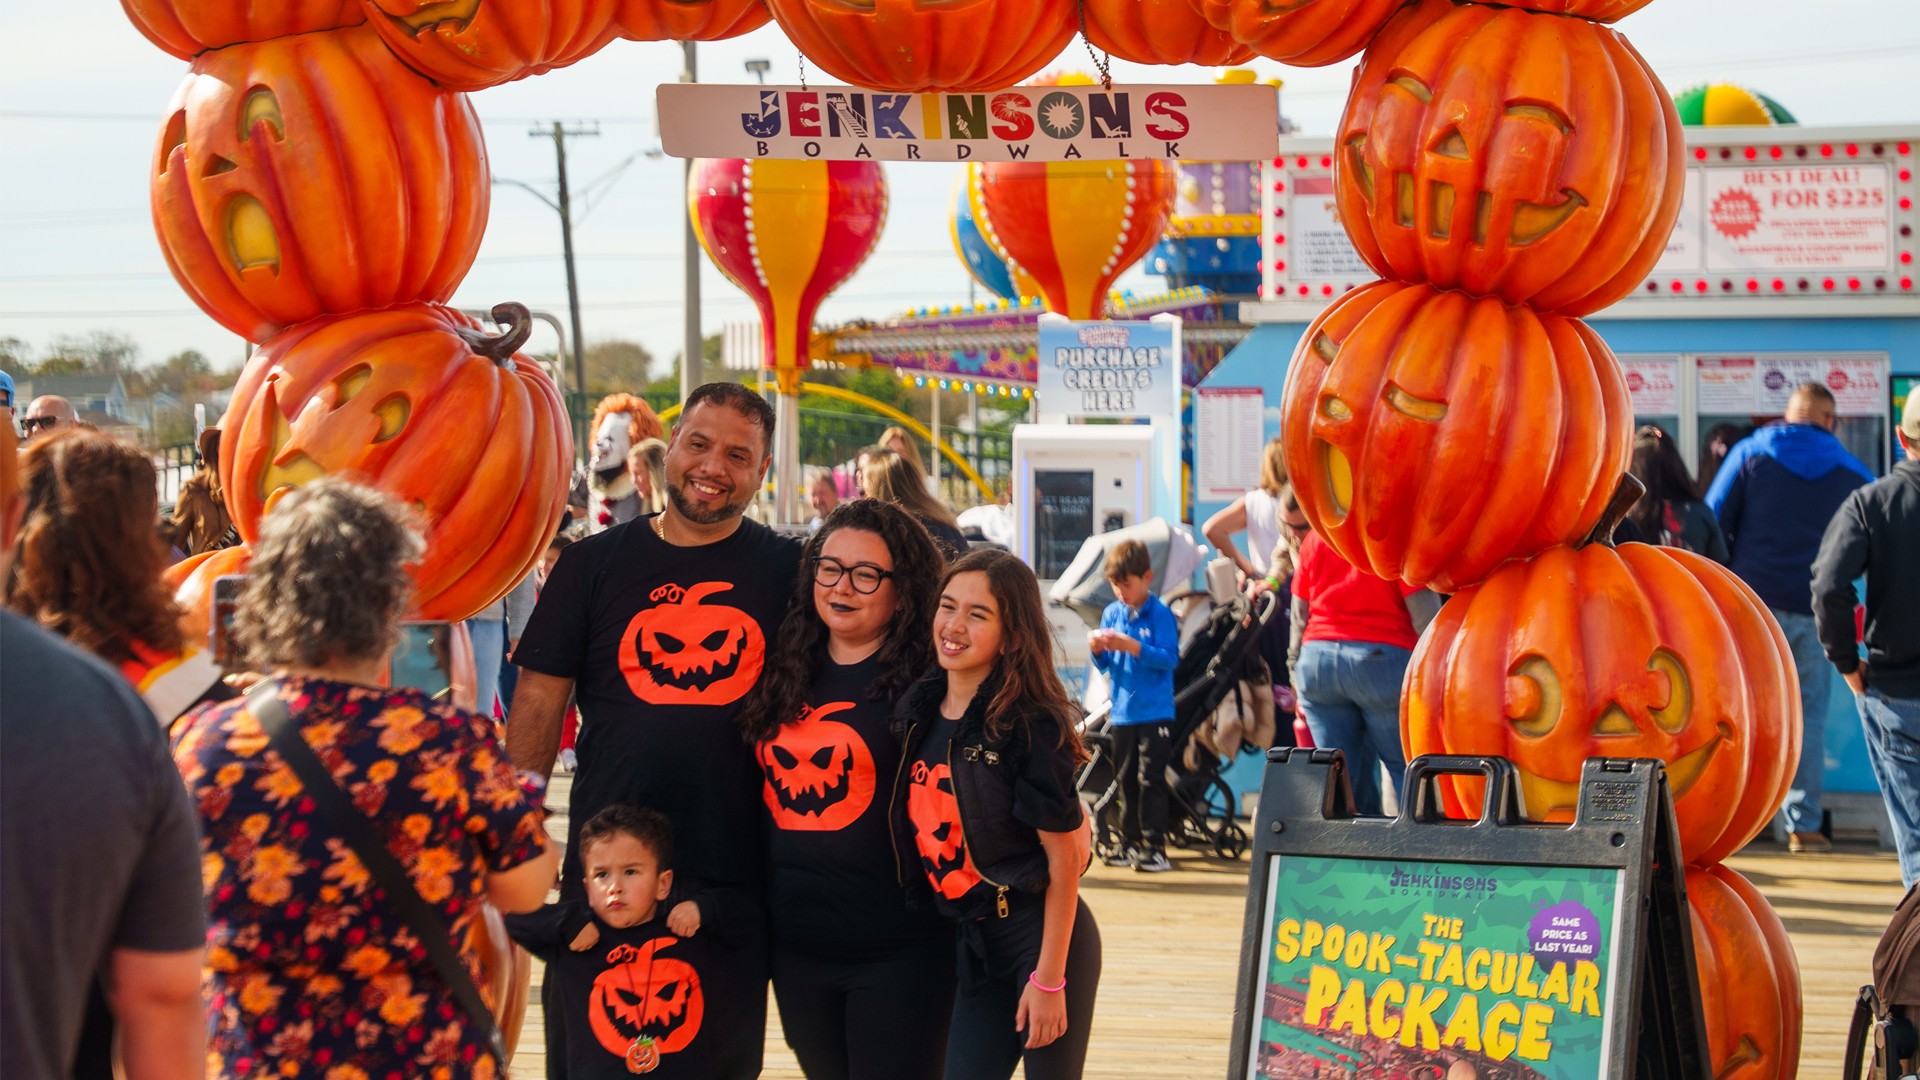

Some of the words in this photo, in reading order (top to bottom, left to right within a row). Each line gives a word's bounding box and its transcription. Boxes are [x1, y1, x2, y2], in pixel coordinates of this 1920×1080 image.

[741, 91, 1190, 141] JENKINSONS
[756, 140, 1181, 160] BOARDWALK
[1743, 169, 1793, 185] BEST
[1800, 167, 1860, 184] DEAL!
[1771, 188, 1819, 208] FOR
[1826, 188, 1884, 208] $225
[1055, 347, 1161, 368] PURCHASE
[1063, 367, 1152, 390] CREDITS
[1082, 389, 1134, 411] HERE
[1390, 868, 1498, 892] JENKINSONS
[1390, 888, 1496, 900] BOARDWALK
[1423, 912, 1464, 941] THE
[1551, 916, 1581, 927] SAME
[1541, 928, 1573, 940] PRICE
[1573, 931, 1588, 941] AS
[1534, 941, 1561, 952] LAST
[1561, 942, 1593, 955] YEAR!
[1275, 918, 1602, 1018] SPOOK-TACULAR
[1303, 963, 1555, 1062] PACKAGE
